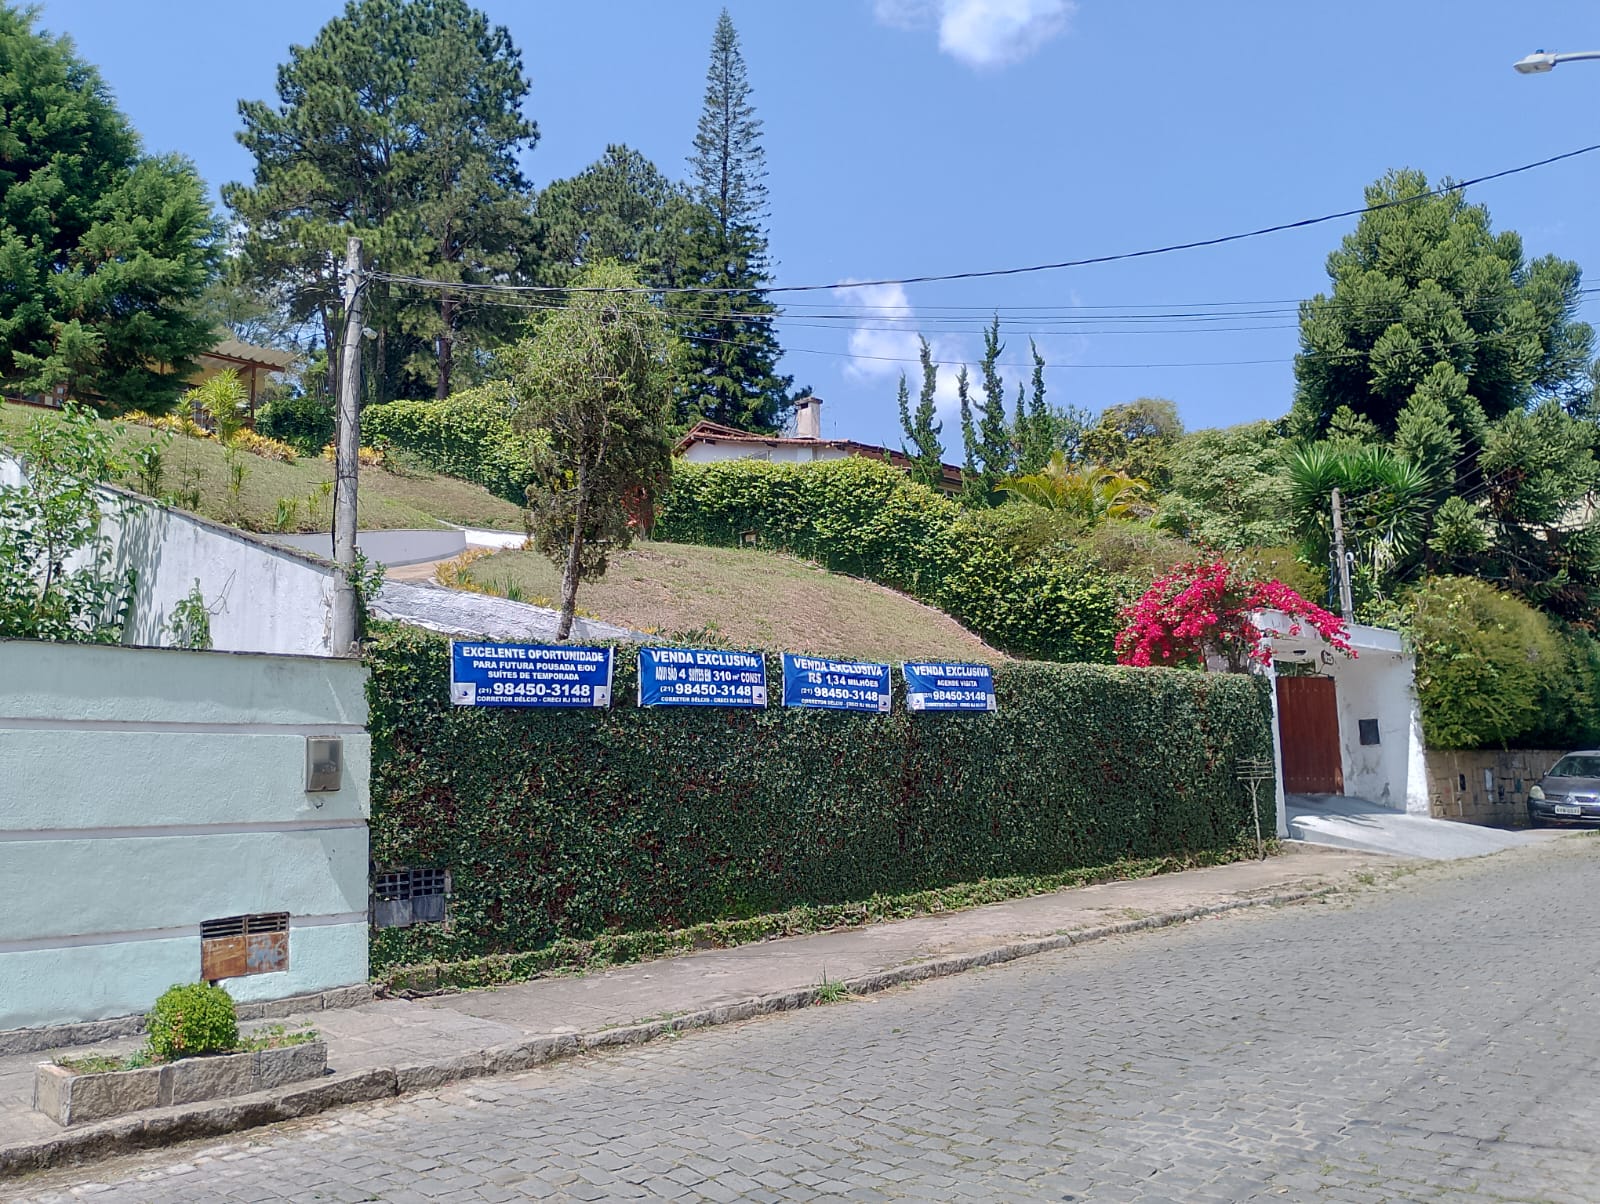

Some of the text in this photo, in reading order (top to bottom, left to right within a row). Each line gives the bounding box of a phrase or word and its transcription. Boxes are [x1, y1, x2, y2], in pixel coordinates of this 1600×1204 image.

[463, 646, 604, 662] EXCELENTE OPORTUNIDADE
[651, 650, 759, 667] VENDA EXCLUSIVA
[473, 660, 596, 672] PARA FUTURA POUSADA E/OU
[793, 657, 883, 677] VENDA EXCLUSIVA
[911, 665, 990, 677] VENDA EXCLUSIVA
[487, 670, 580, 681] SUÍTES DE TEMPORADA
[678, 668, 687, 680] 4
[713, 670, 732, 682] 310
[808, 672, 823, 685] R$
[826, 674, 847, 687] 1,34
[493, 682, 590, 697] 98450-3148
[660, 683, 751, 696] (21) 98450-3148
[814, 686, 878, 702] 98450-3148
[933, 690, 986, 701] 98450-3148
